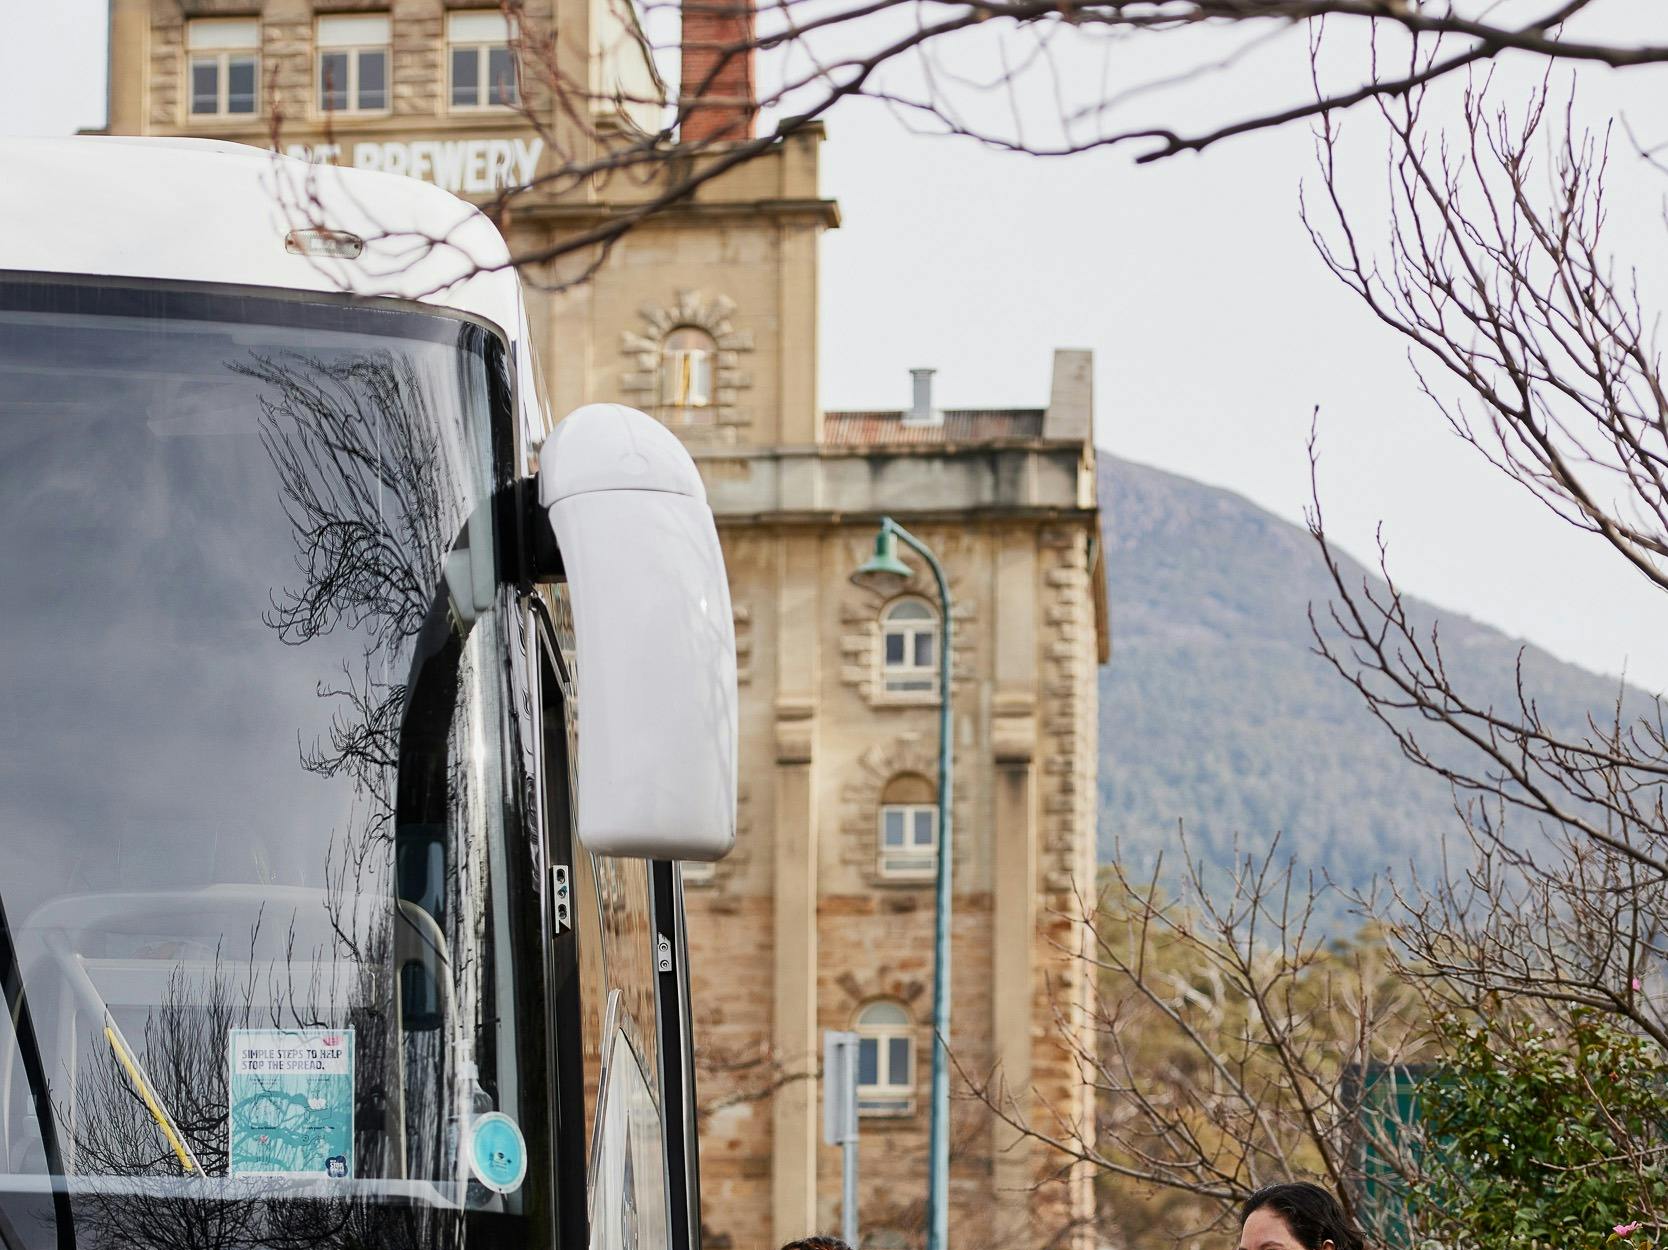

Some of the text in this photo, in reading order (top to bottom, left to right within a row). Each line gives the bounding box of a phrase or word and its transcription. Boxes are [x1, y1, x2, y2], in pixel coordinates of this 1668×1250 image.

[242, 1049, 342, 1059] SIMPLE STEPS TO HELP
[242, 1060, 325, 1070] STOP THE SPREAD.
